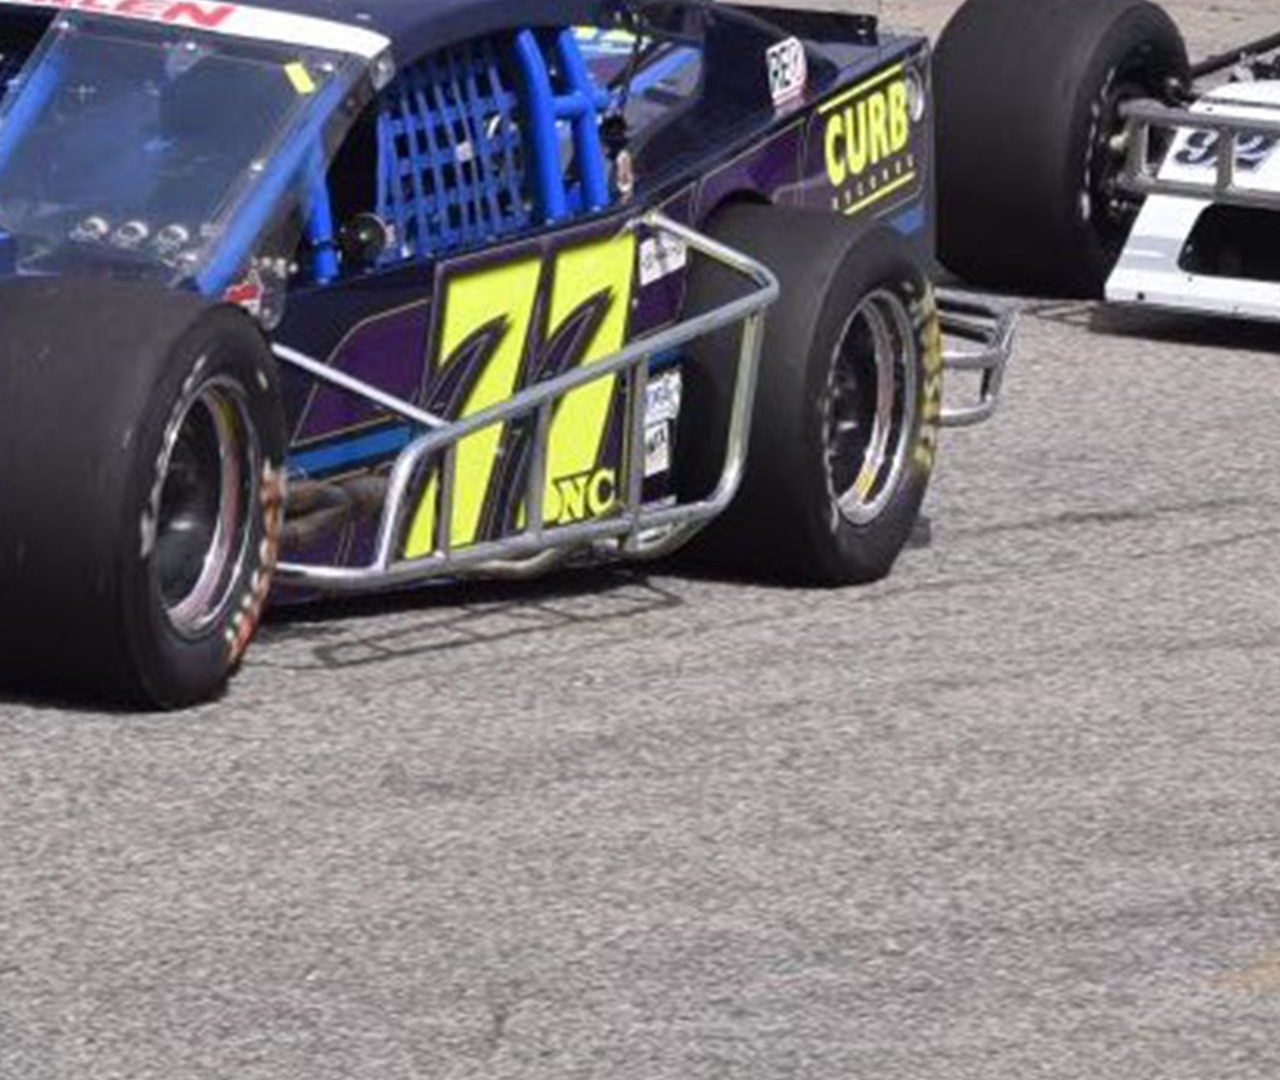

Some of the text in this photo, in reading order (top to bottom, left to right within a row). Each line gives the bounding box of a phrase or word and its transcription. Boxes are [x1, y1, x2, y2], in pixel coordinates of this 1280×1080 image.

[825, 81, 910, 187] CURB
[404, 234, 637, 560] 77
[554, 468, 616, 526] NC
